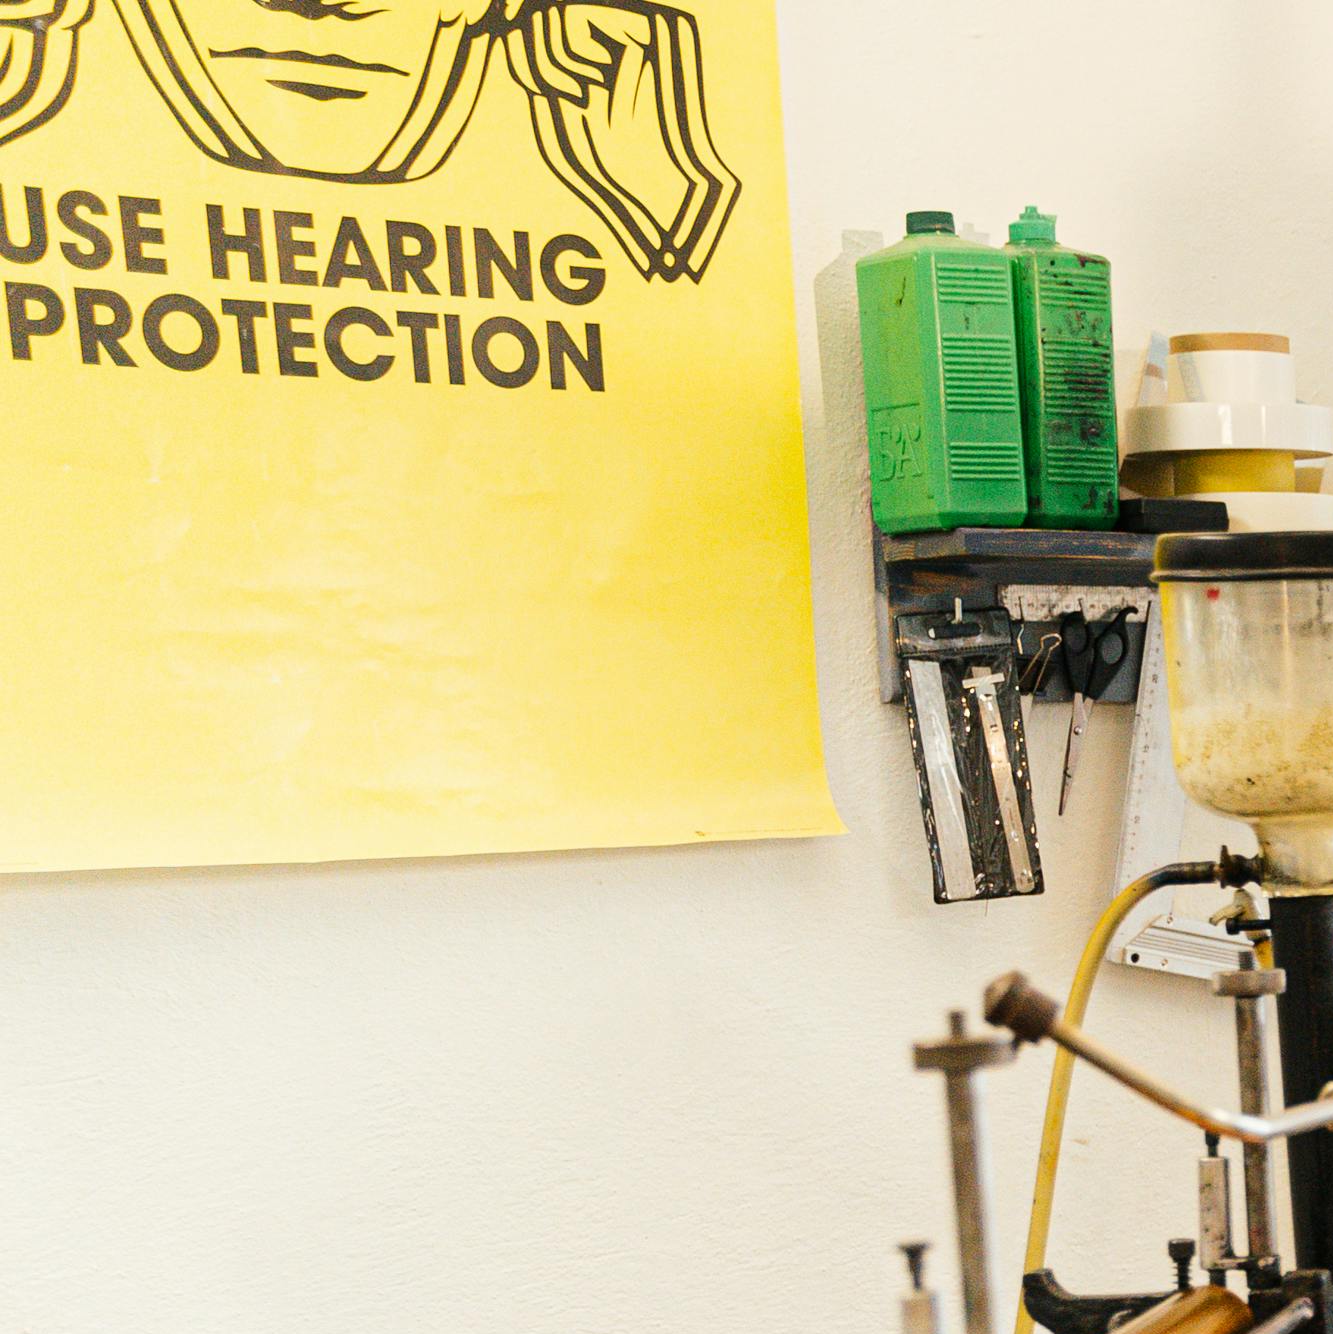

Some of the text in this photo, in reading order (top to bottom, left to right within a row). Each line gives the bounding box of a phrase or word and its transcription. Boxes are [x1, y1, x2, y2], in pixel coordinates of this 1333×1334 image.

[0, 186, 606, 306] USE HEARING
[4, 281, 606, 393] PROTECTION
